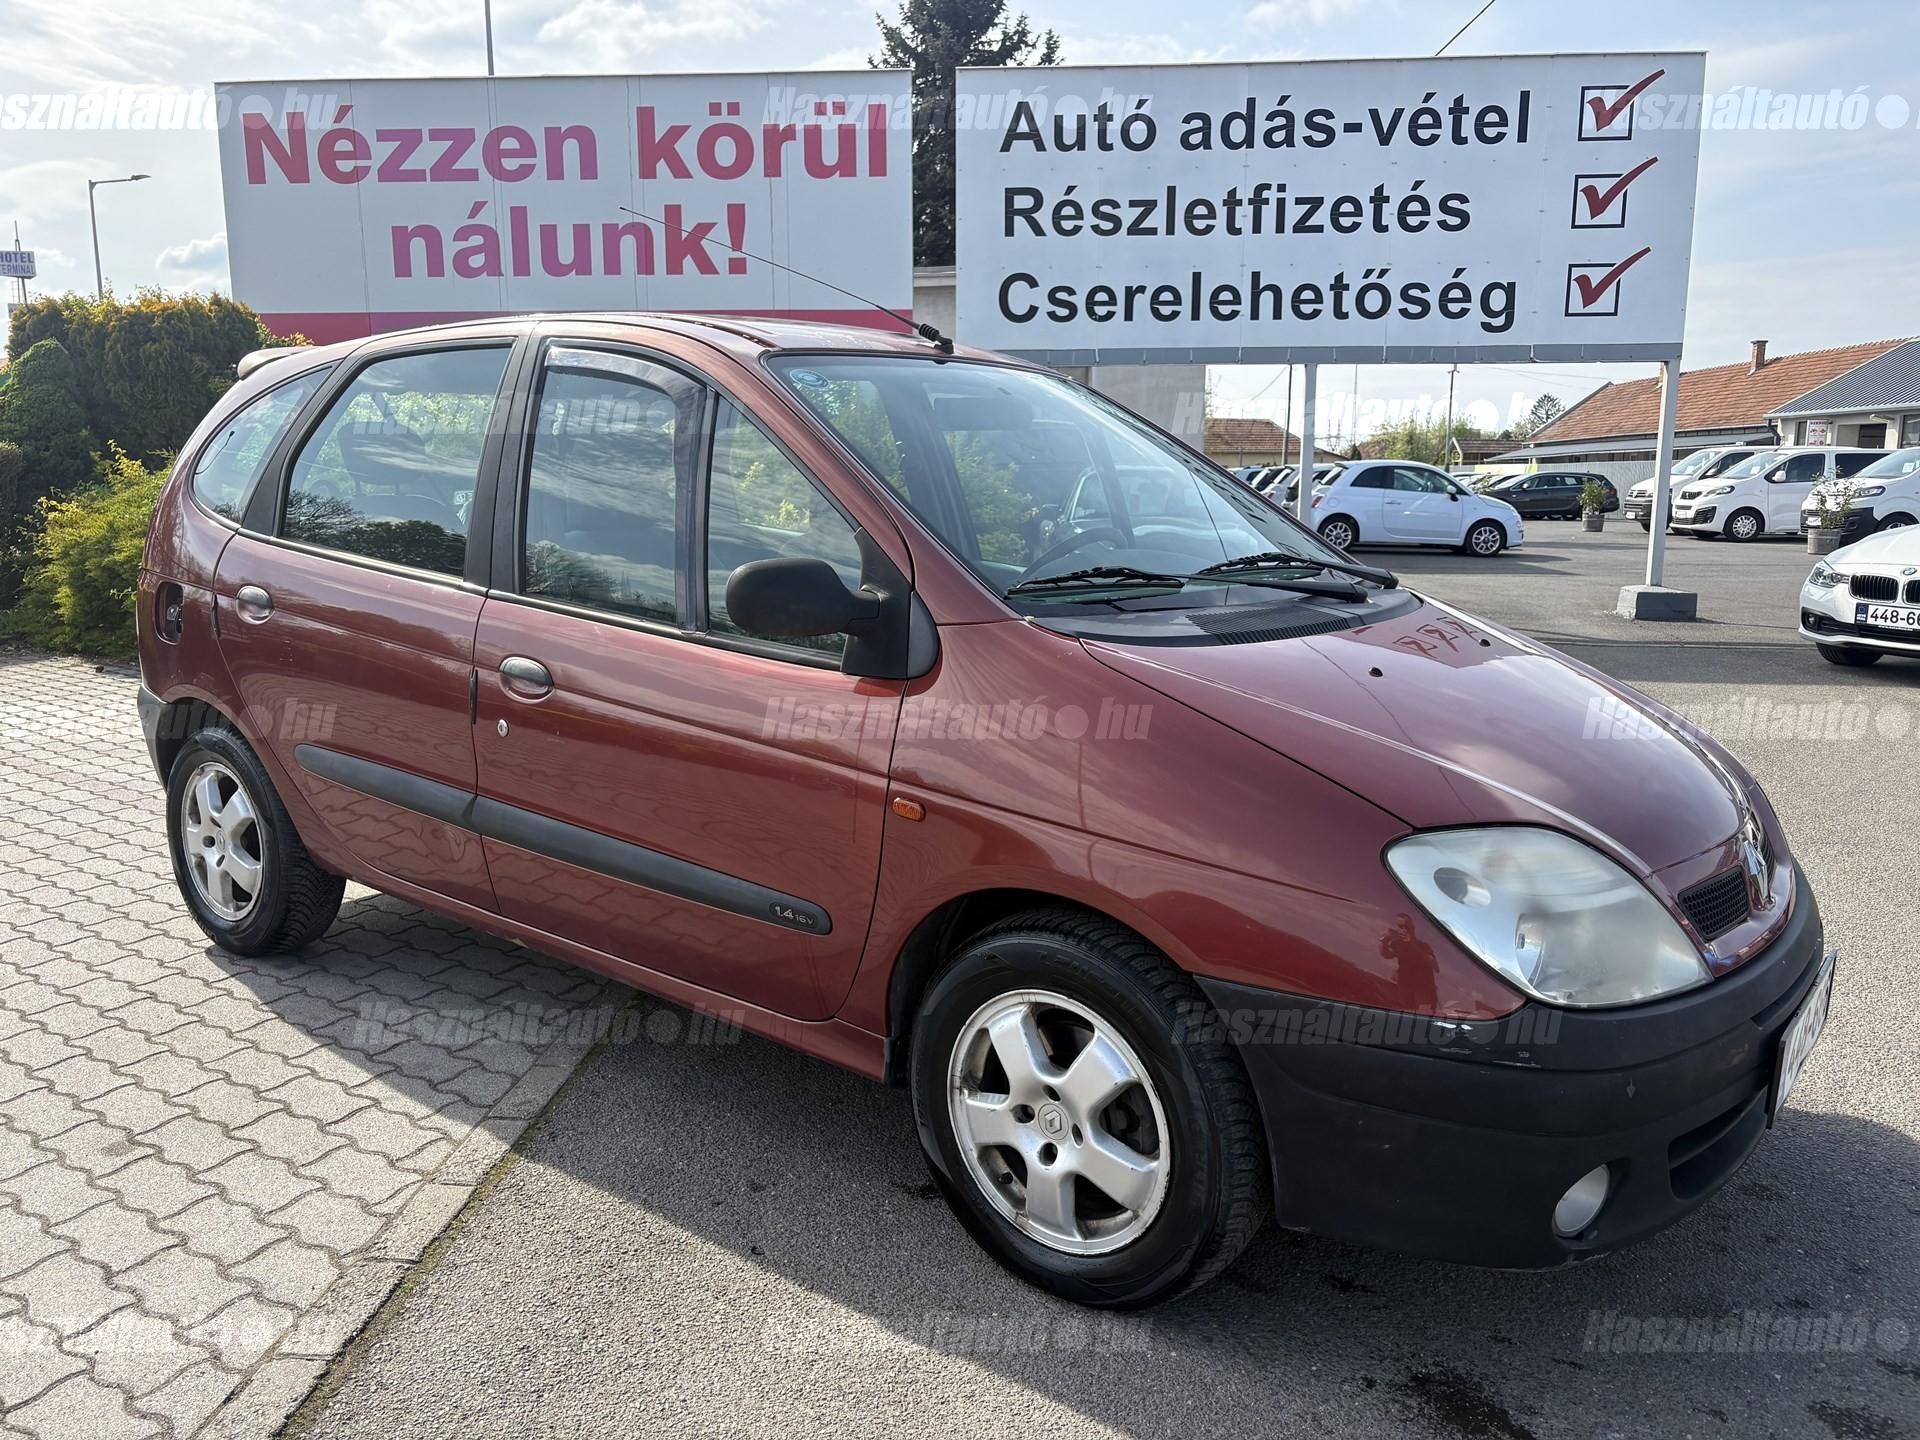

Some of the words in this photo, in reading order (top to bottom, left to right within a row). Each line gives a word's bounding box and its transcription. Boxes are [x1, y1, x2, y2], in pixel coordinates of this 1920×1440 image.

[243, 105, 598, 185] Nézzen
[635, 101, 888, 181] körül
[999, 98, 1157, 153] Autó
[1180, 90, 1531, 152] adás-vétel
[392, 201, 748, 279] nálunk!
[1004, 180, 1471, 238] Részletfizetés
[998, 268, 1517, 334] Cserelehetőség
